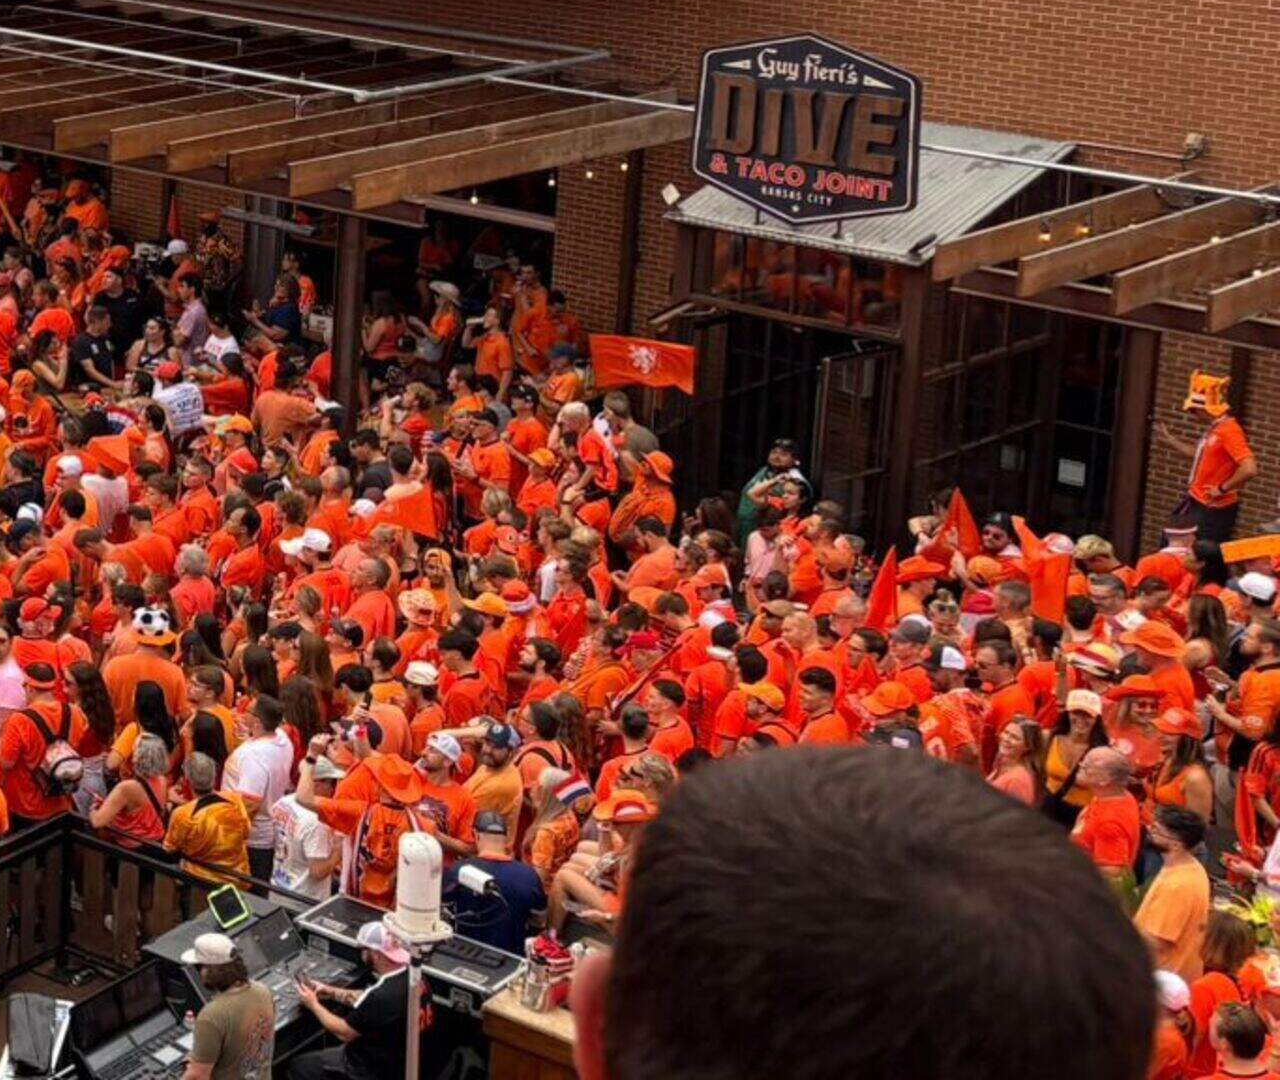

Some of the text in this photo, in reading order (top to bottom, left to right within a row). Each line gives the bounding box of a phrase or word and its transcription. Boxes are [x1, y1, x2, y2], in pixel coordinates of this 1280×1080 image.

[757, 48, 800, 82] Guy
[708, 71, 906, 175] DIVE
[709, 153, 893, 202] & TACO JOINT
[761, 185, 834, 207] KANSAS CITY
